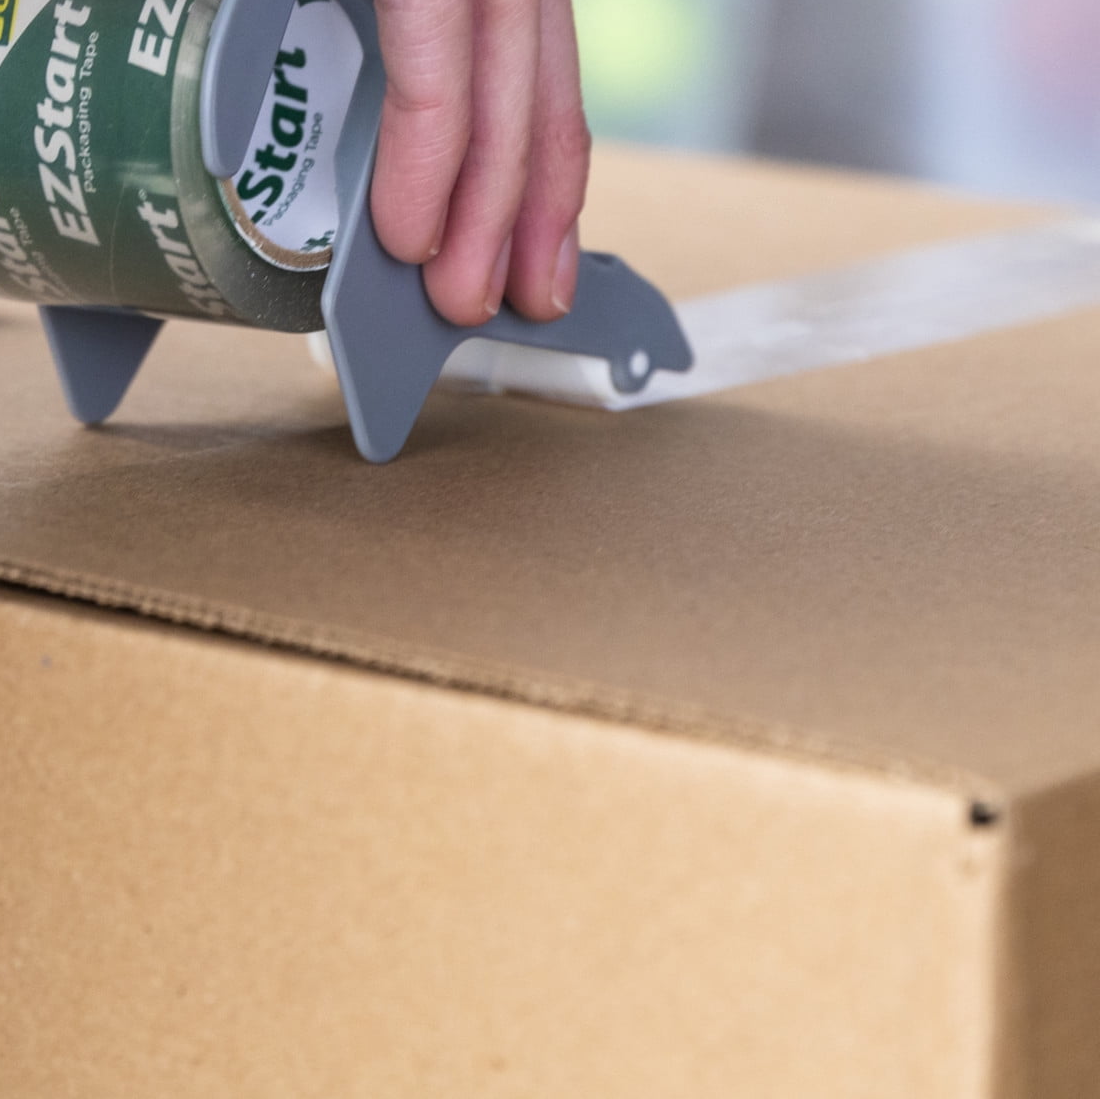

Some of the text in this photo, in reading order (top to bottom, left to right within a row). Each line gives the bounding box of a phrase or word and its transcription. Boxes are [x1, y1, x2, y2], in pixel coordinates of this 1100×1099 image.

[79, 31, 99, 80] Tape
[237, 47, 308, 224] Start
[305, 111, 323, 153] Tape
